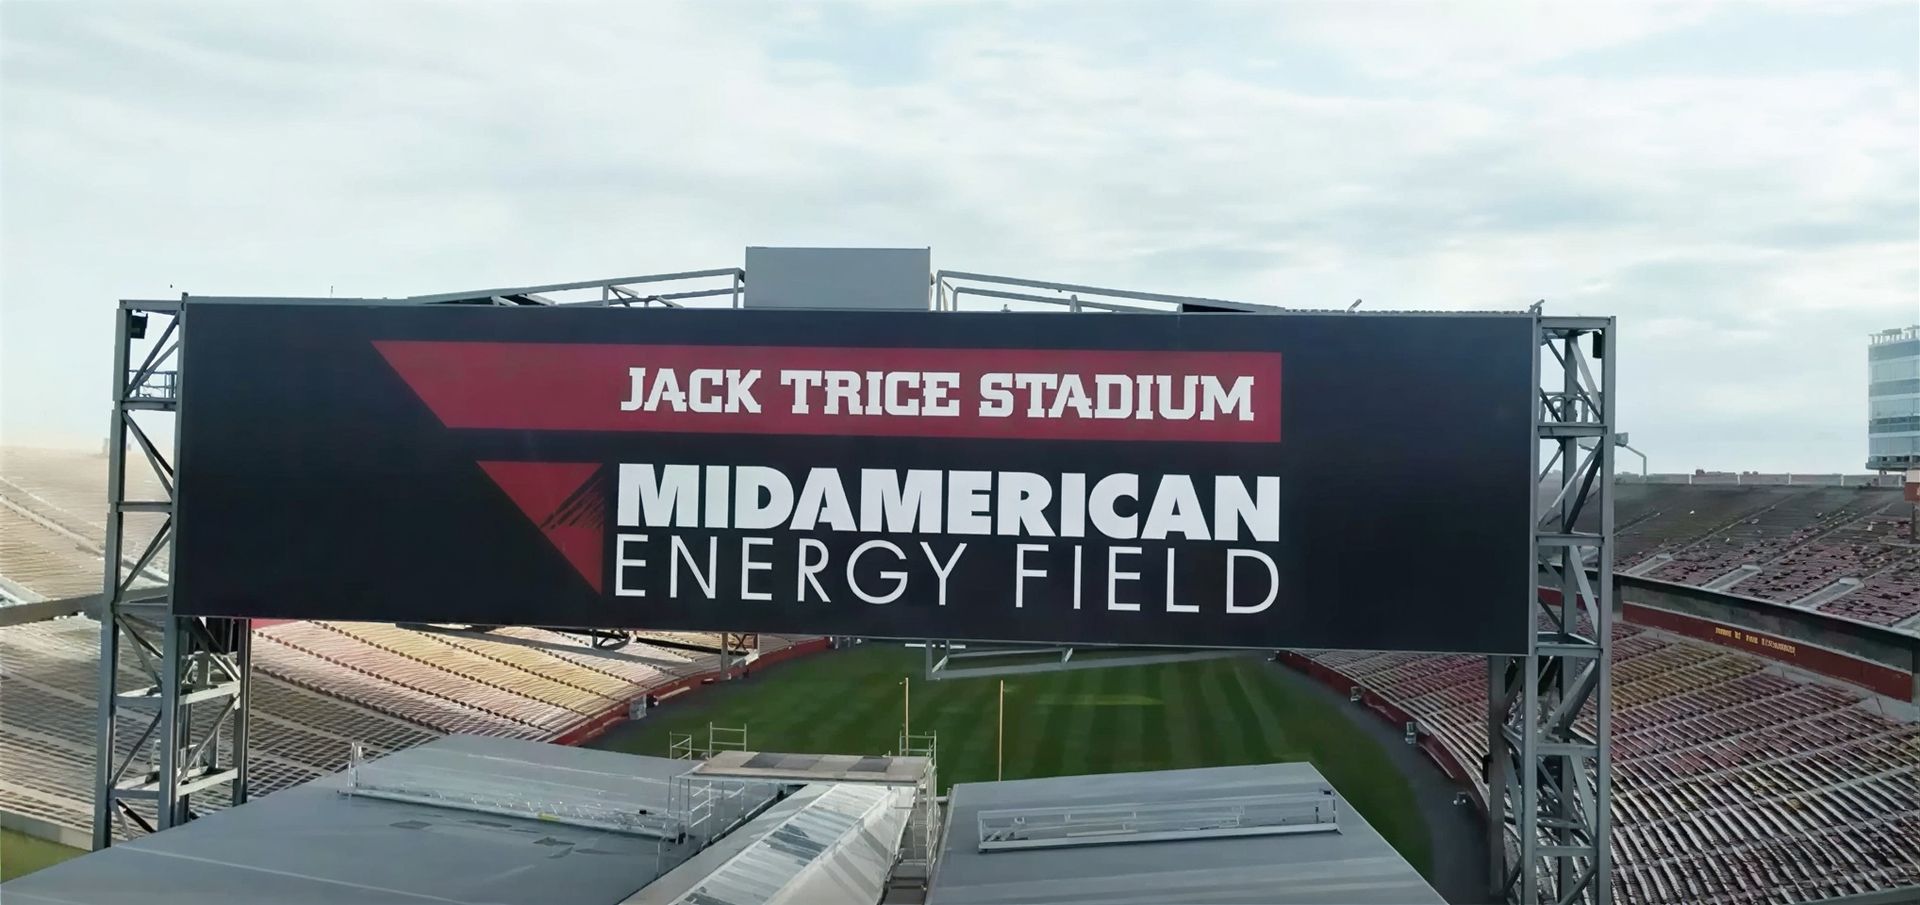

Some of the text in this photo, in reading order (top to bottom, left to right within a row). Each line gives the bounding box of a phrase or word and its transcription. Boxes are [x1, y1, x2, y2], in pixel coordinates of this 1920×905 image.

[620, 366, 1255, 422] JACK TRICE STADIUM
[617, 463, 1281, 542] MIDAMERICAN
[615, 533, 1280, 614] ENERGY FIELD
